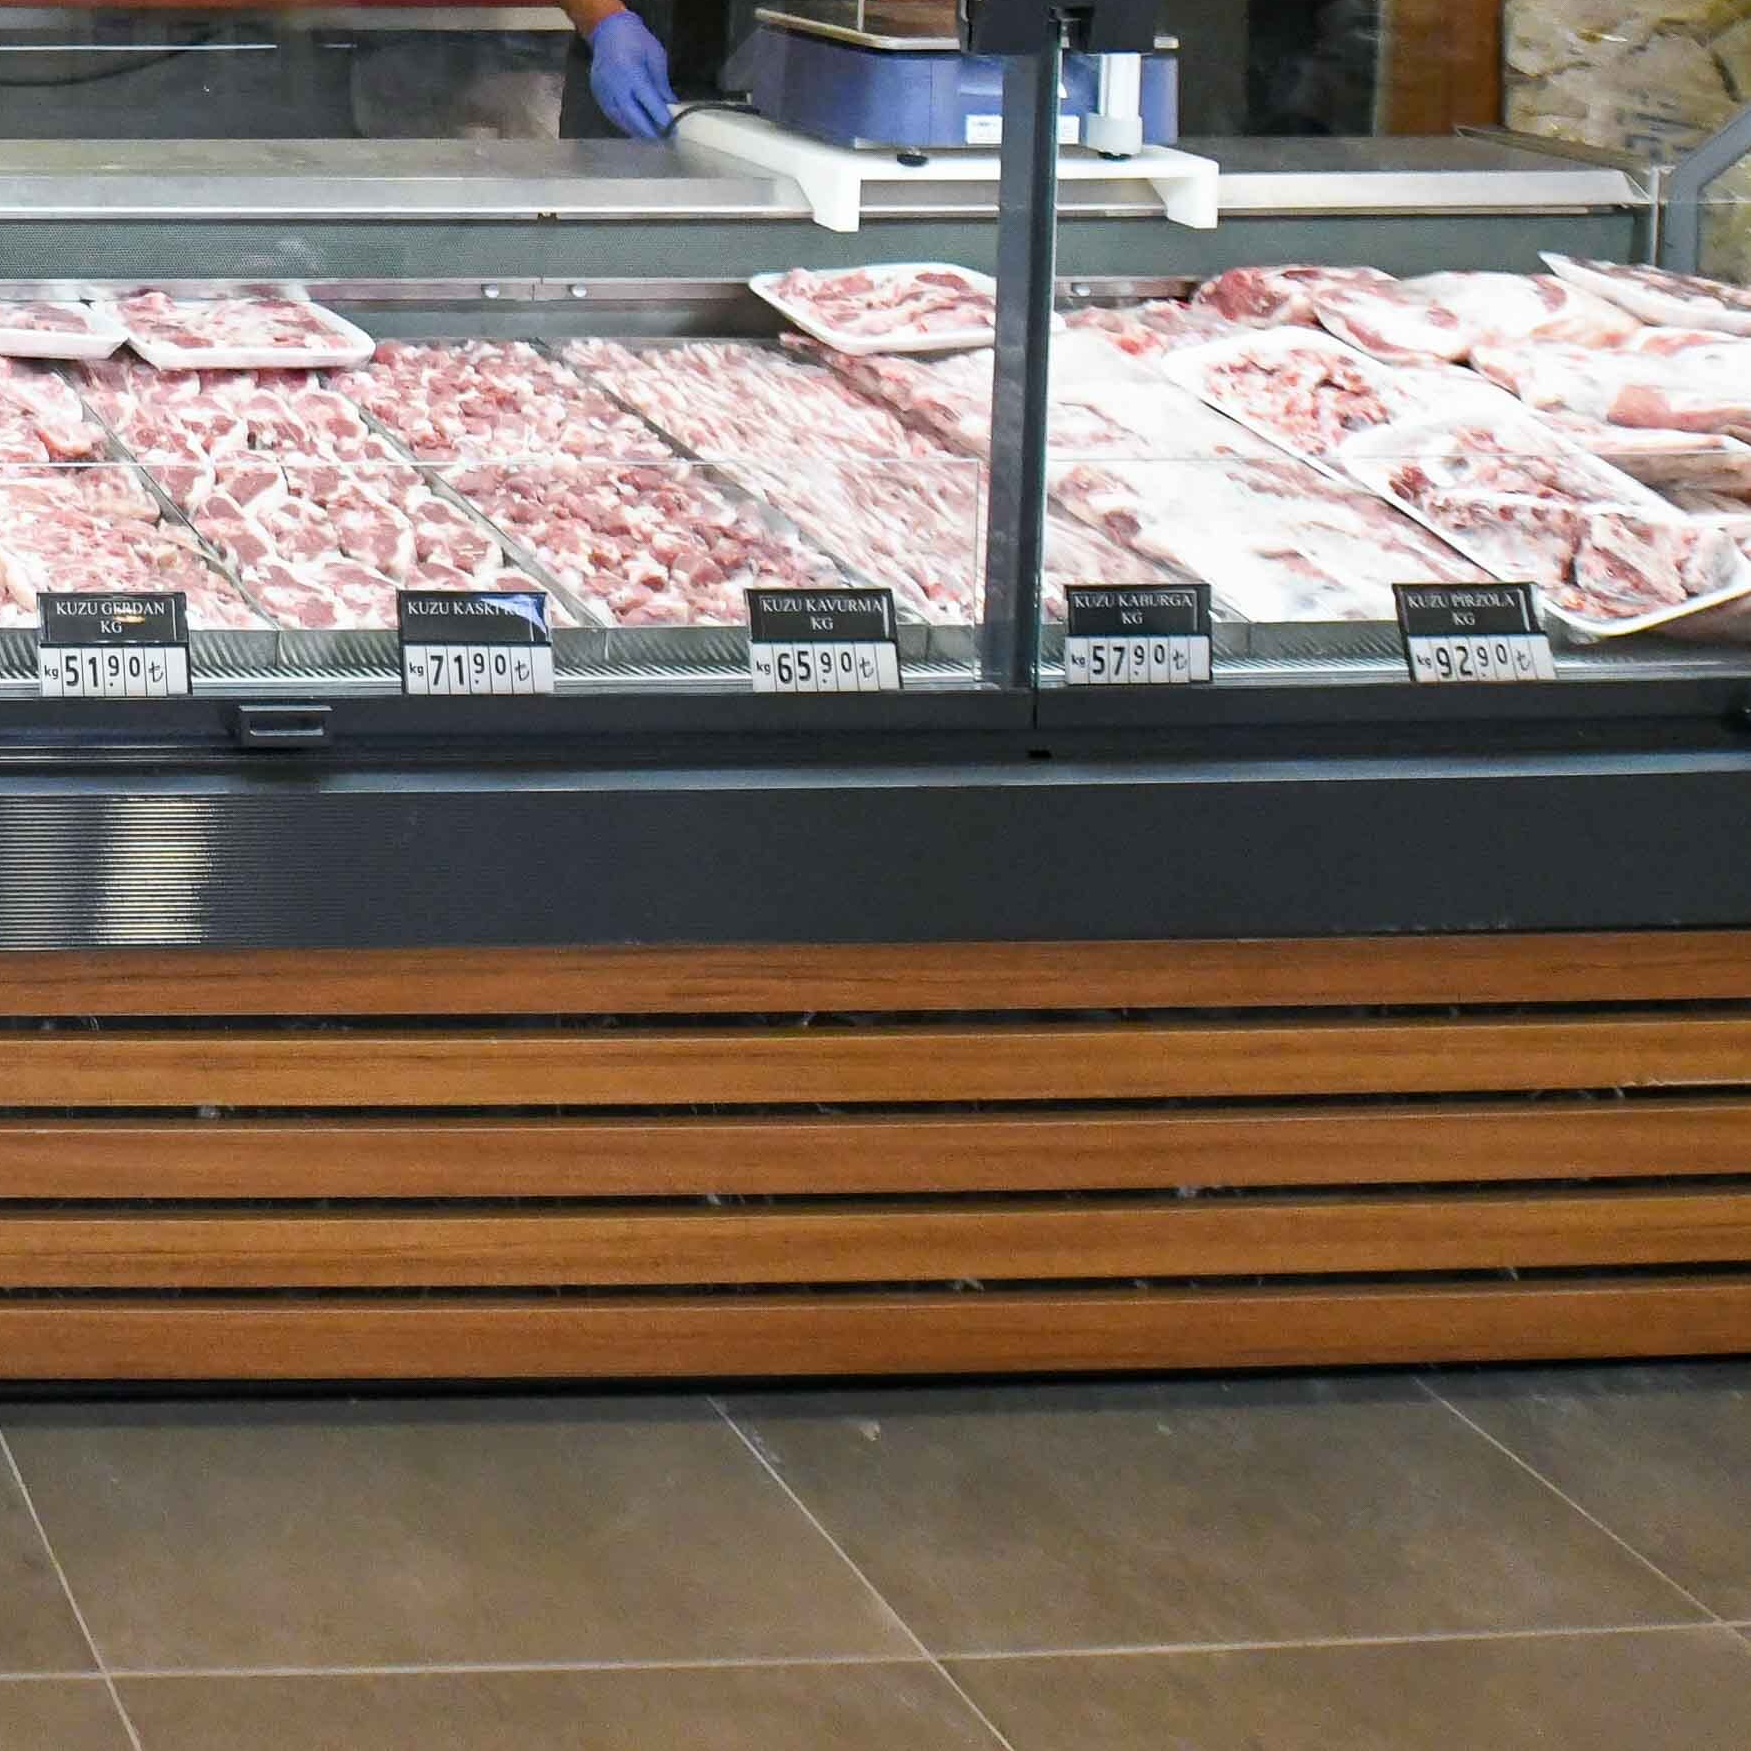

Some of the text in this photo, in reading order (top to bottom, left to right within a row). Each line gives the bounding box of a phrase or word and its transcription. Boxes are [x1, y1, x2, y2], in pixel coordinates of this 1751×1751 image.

[408, 601, 450, 615] KUZU
[762, 599, 884, 613] KUZU KAVURMA
[1074, 594, 1115, 608] KUZU
[56, 602, 166, 616] KUZU GERDAN
[811, 616, 834, 631] KG
[1121, 612, 1145, 625] KG
[1452, 611, 1477, 626] KG
[100, 620, 123, 635] KG
[756, 660, 771, 675] kg
[777, 651, 853, 685] 65.90
[1092, 644, 1166, 677] 57.90
[1436, 643, 1508, 678] 92.90
[44, 665, 59, 680] kg
[64, 655, 141, 688] 51.90
[409, 662, 424, 677] kg
[430, 652, 507, 686] 71.90
